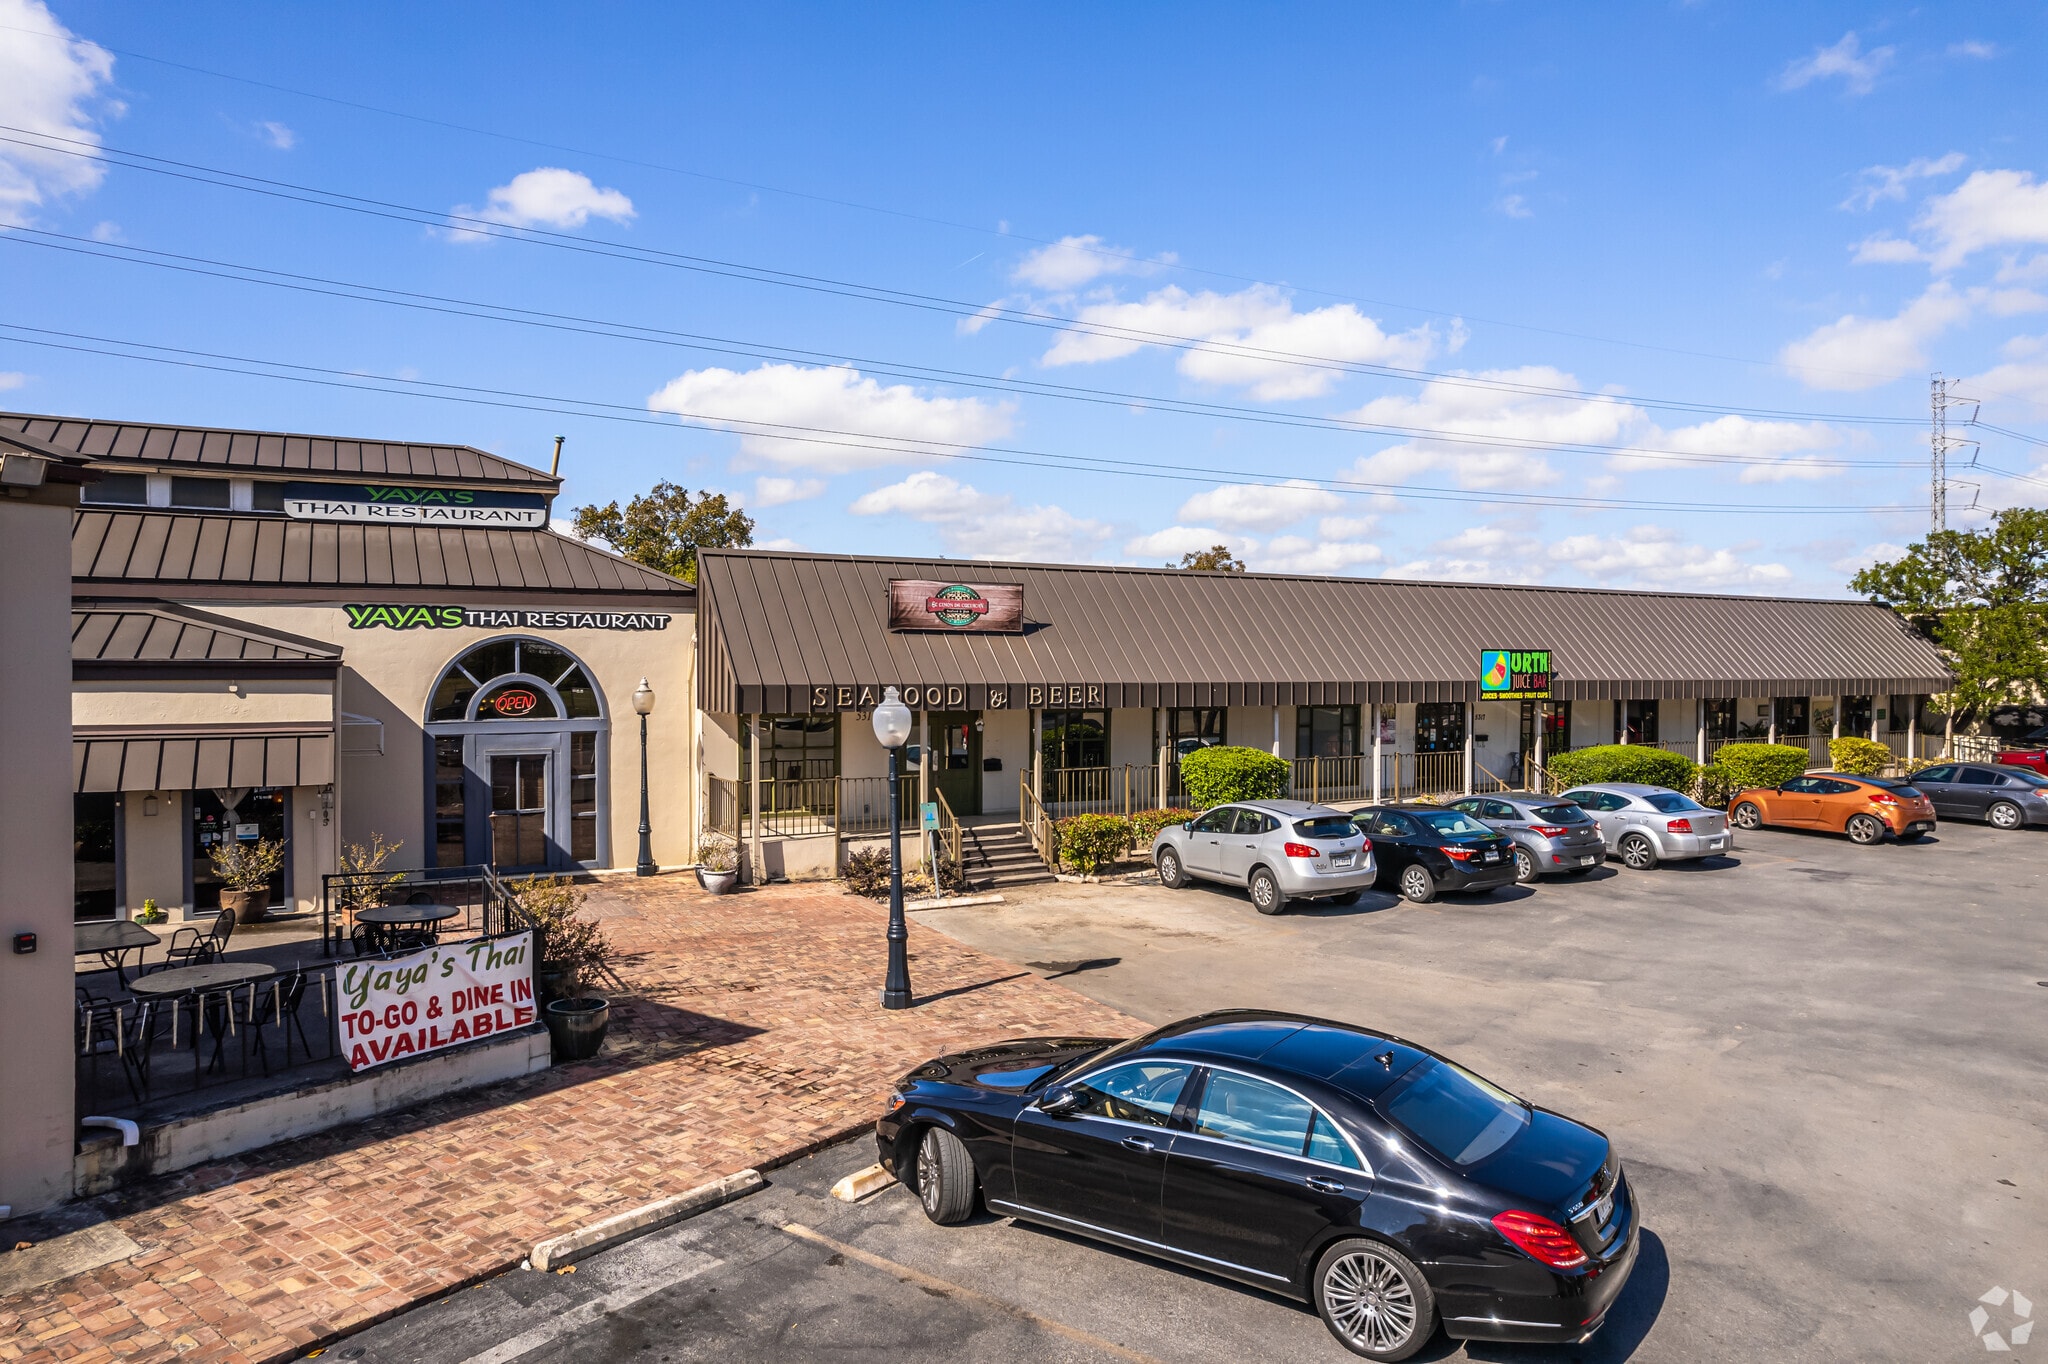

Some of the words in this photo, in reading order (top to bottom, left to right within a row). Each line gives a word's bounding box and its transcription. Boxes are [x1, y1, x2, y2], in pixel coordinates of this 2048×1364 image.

[365, 486, 474, 504] YAYA'S
[292, 501, 357, 516] THAI
[367, 505, 538, 522] RESTAURANT
[346, 607, 463, 627] YAYA'S
[464, 611, 519, 626] THAI
[527, 612, 669, 629] RESTAURANT
[1511, 652, 1548, 673] URTH
[1512, 674, 1531, 691] JUICE
[1533, 674, 1547, 688] BAR
[497, 695, 533, 710] OPEN
[812, 686, 963, 707] SEAOOD
[990, 689, 1007, 709] &
[1029, 685, 1102, 705] BEER
[342, 951, 456, 1010] Yaya's
[466, 937, 528, 972] Thai
[342, 1000, 418, 1039] TO-GO
[426, 995, 443, 1020] &
[452, 983, 504, 1015] DINE
[510, 977, 532, 1003] IN
[351, 1005, 534, 1070] AVAILABLE
